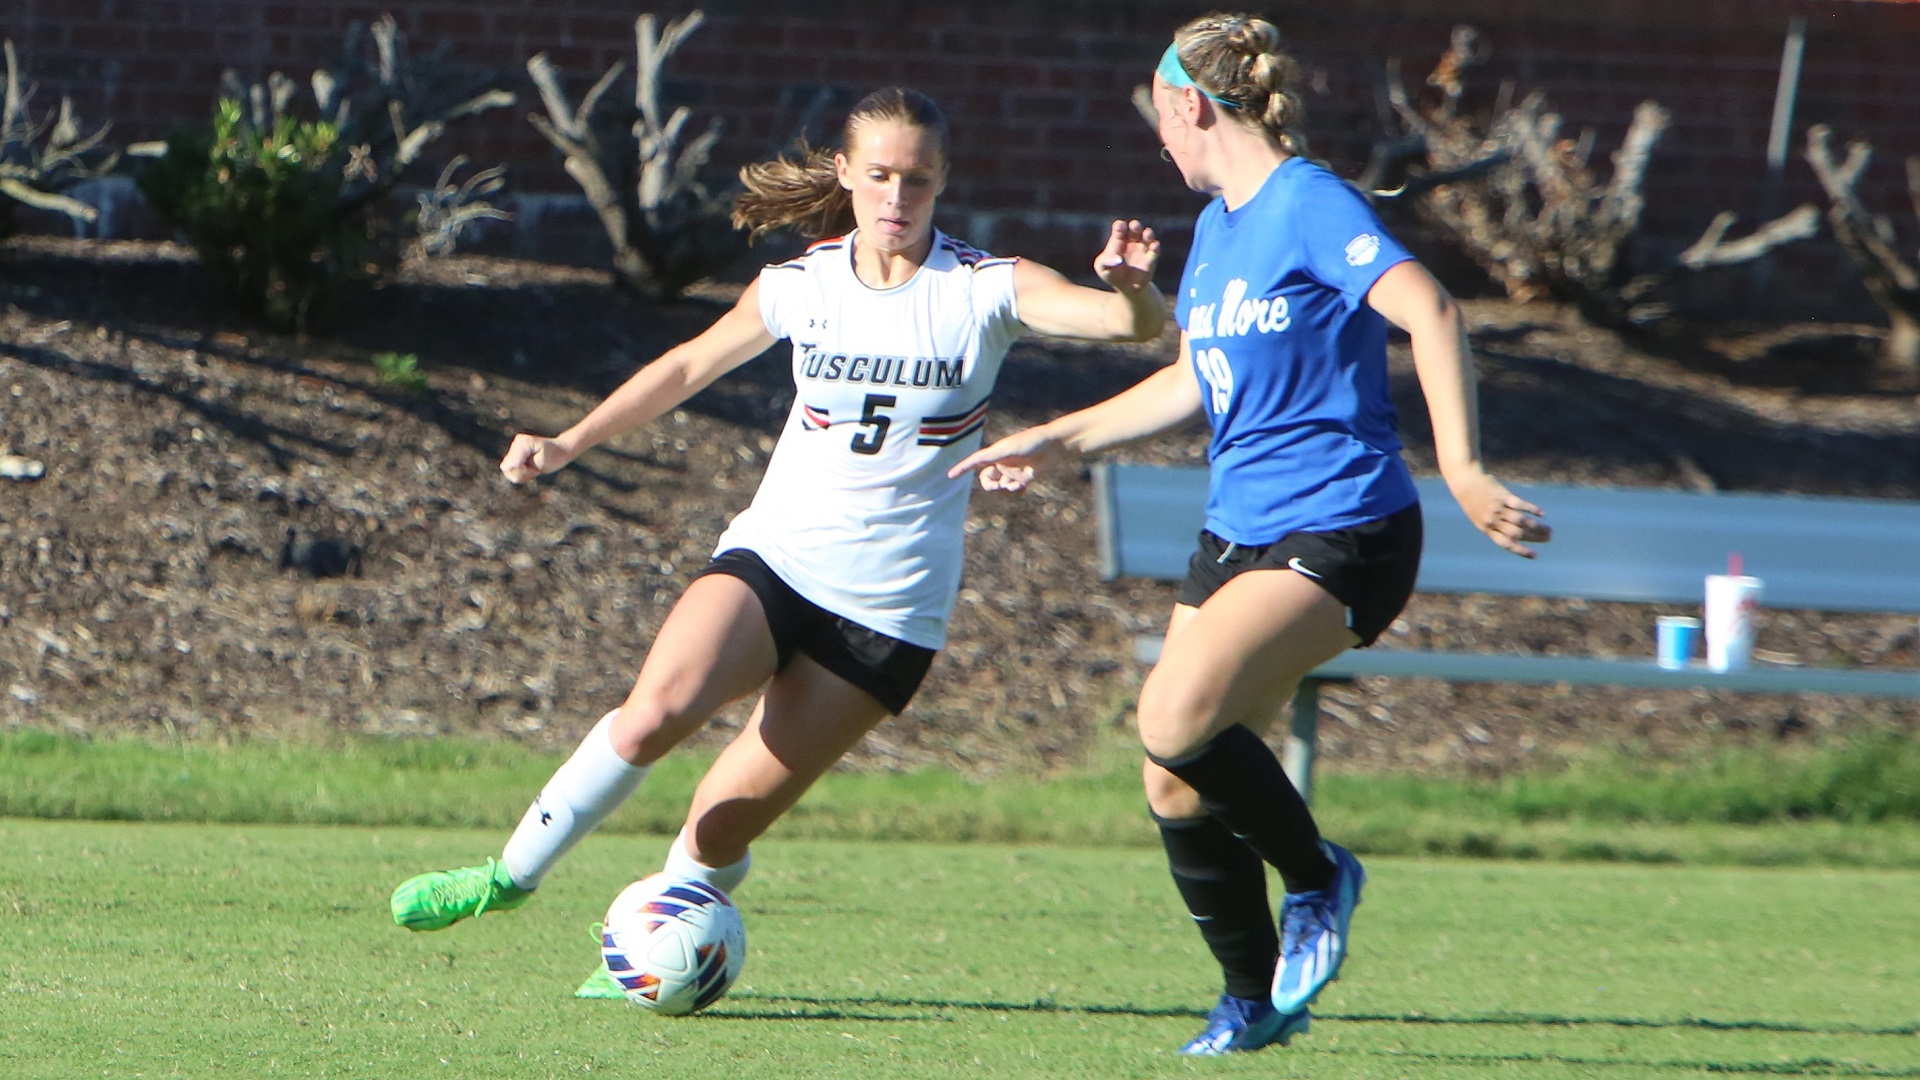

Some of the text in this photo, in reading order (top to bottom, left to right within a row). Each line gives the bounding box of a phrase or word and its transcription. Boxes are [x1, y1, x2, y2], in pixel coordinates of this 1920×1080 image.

[1217, 278, 1291, 337] More
[799, 341, 965, 389] TUSCULUM
[1196, 348, 1233, 414] 19
[851, 393, 896, 454] 5
